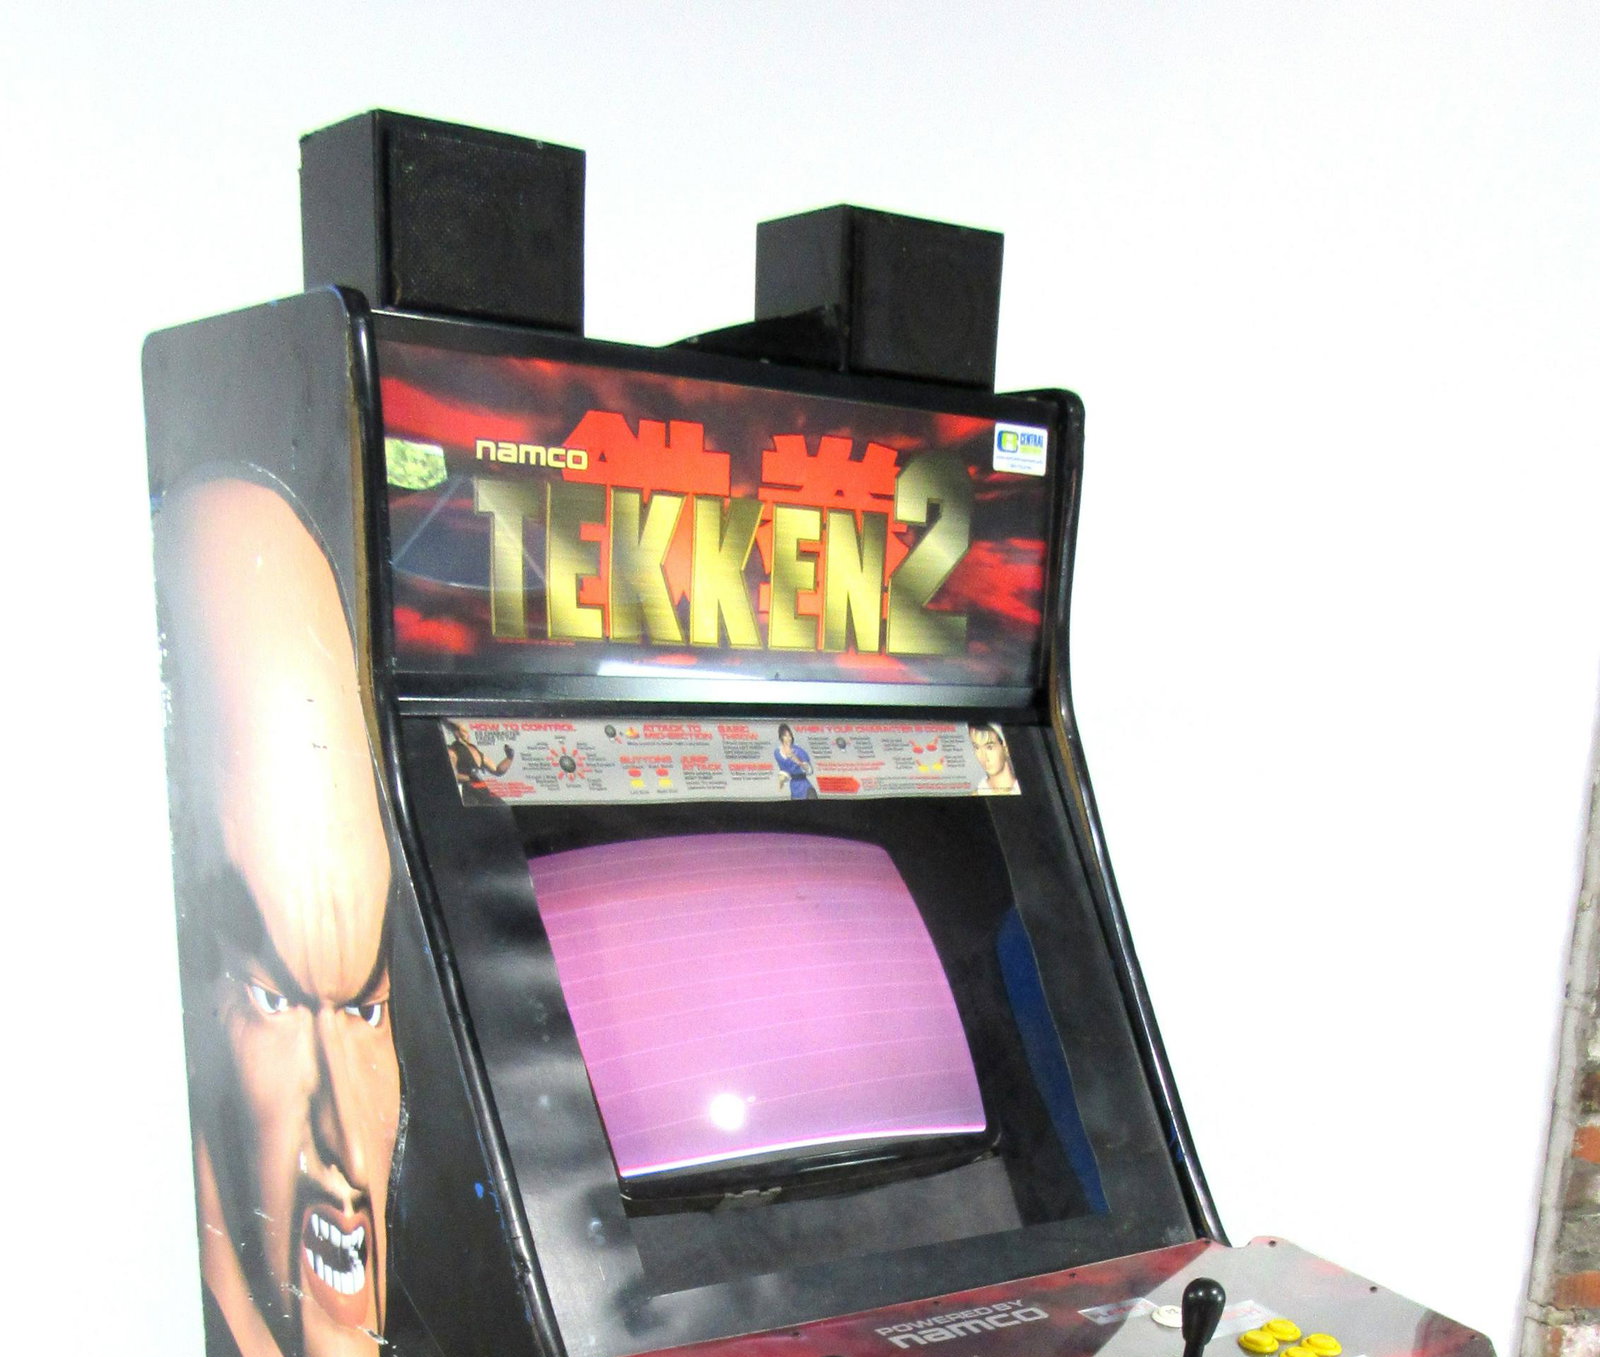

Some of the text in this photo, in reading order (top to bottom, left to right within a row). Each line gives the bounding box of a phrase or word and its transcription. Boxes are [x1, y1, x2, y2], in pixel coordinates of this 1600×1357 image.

[475, 439, 589, 470] namco
[472, 451, 971, 656] TEKKEN 2
[469, 722, 576, 732] HOW TO CONTROL
[874, 1299, 1024, 1336] POWERED BY
[888, 1306, 1049, 1349] namco
